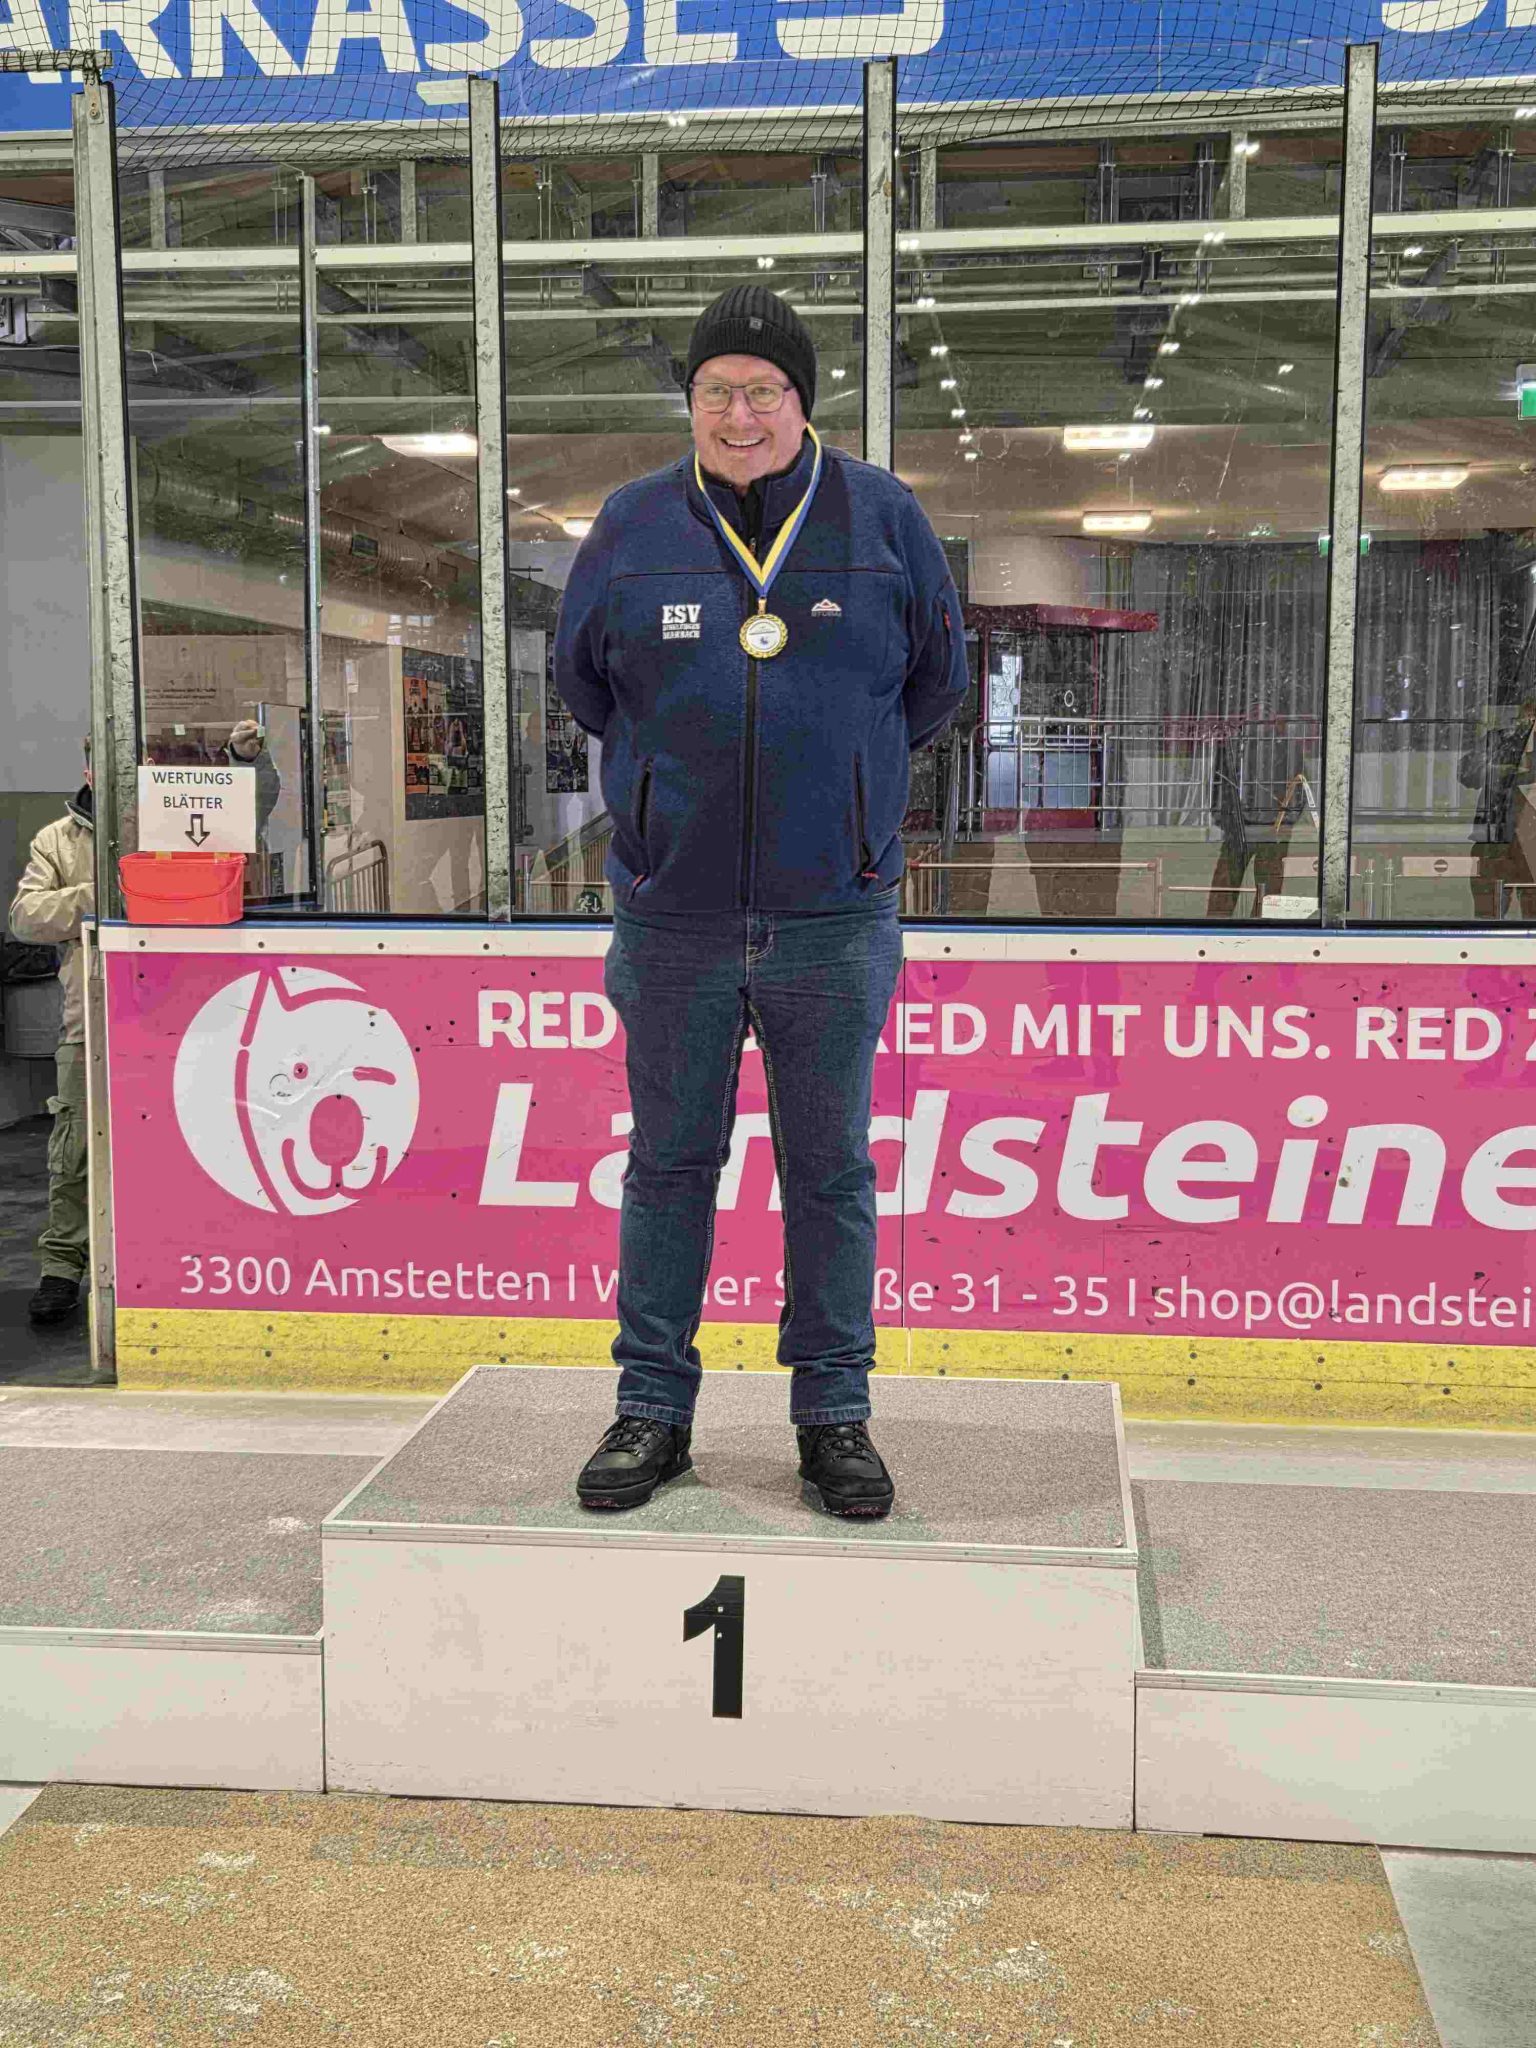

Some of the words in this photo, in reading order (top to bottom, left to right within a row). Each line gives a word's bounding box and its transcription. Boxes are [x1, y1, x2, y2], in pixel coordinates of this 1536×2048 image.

[662, 604, 702, 624] ESV
[152, 771, 233, 785] WERTUNGS
[163, 793, 223, 809] BLÄTTER
[477, 990, 618, 1049] RED
[876, 1002, 987, 1055] ED
[1011, 1003, 1142, 1057] MIT
[1163, 1004, 1331, 1060] UNS.
[1355, 1006, 1502, 1061] RED
[180, 1255, 291, 1295] 3300
[305, 1258, 550, 1301] Amstetten
[950, 1272, 1000, 1313] 31
[1053, 1275, 1109, 1316] 35
[1154, 1276, 1532, 1330] shop@landstei
[683, 1574, 745, 1719] 1
